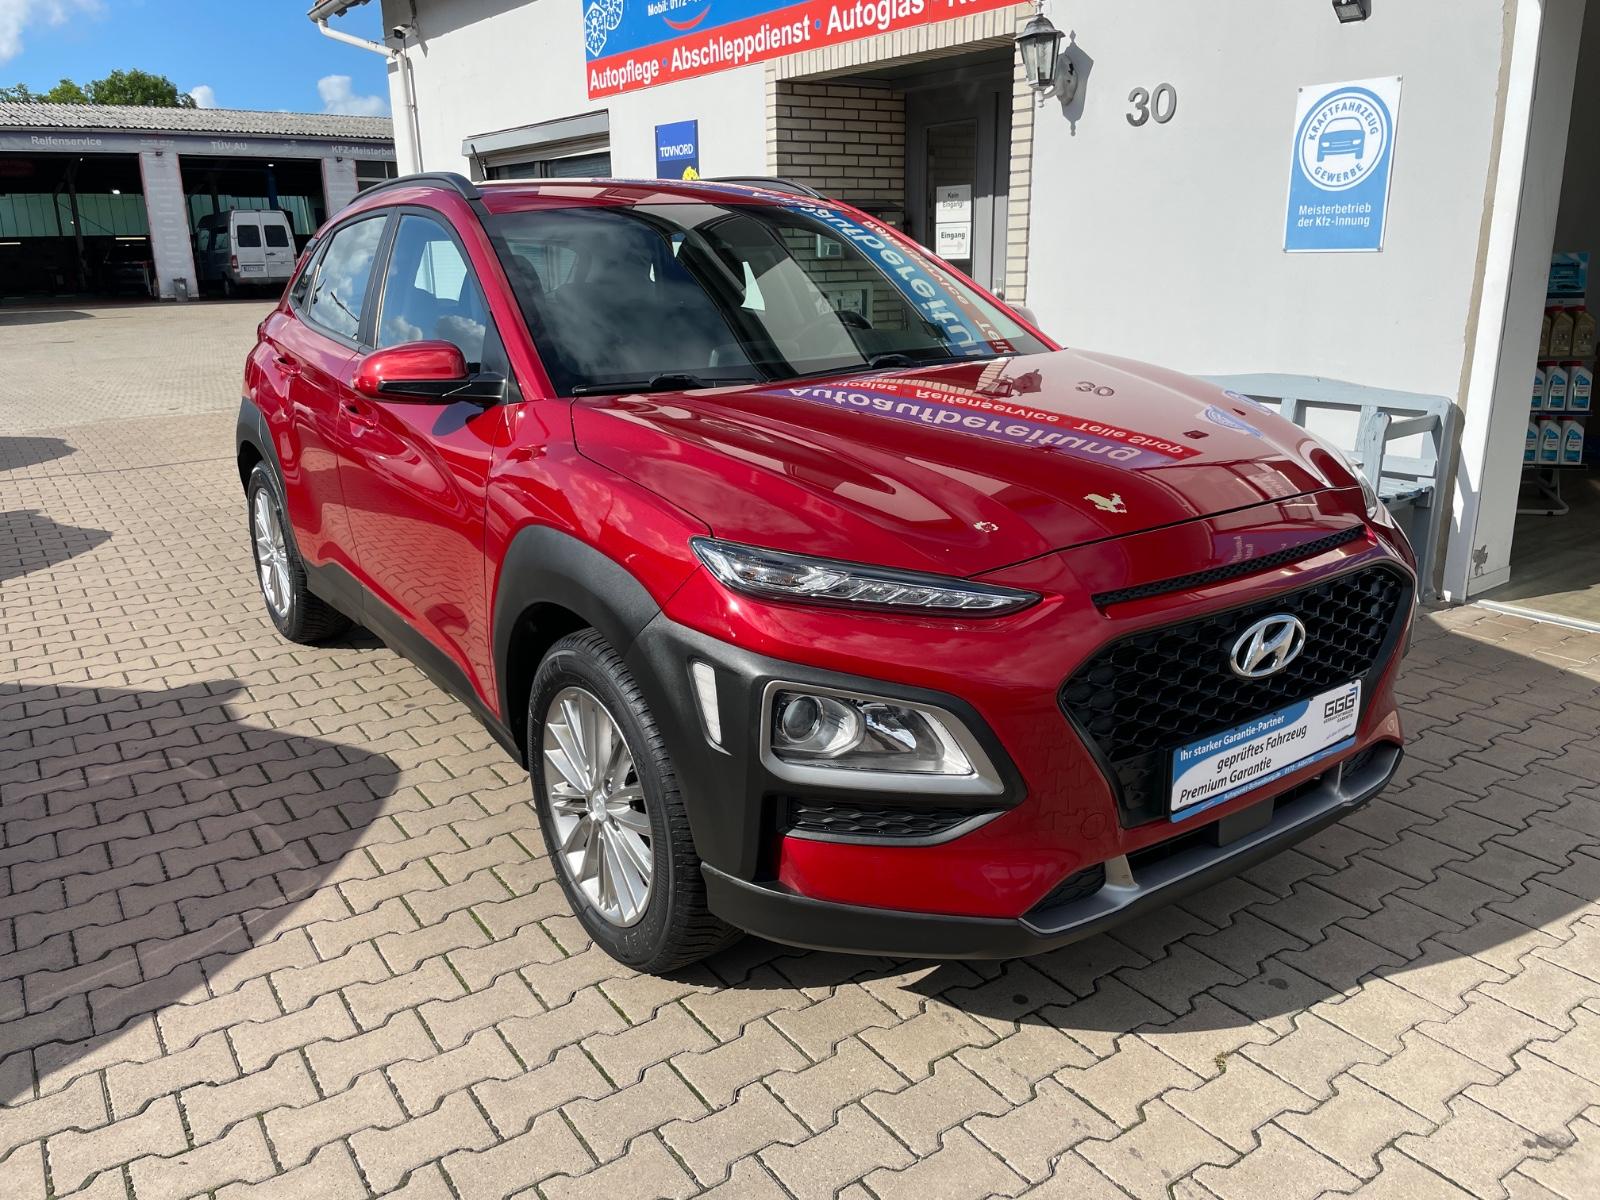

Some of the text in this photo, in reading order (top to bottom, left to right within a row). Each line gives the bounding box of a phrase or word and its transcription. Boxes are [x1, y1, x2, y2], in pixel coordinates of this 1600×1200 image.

[589, 0, 925, 92] Autopflege Abschleppdienst Autoglas
[1125, 82, 1178, 127] 30
[1307, 101, 1379, 141] KRAFTFAHRZEUG
[31, 135, 103, 147] Reifenservice
[1314, 163, 1364, 183] GEWERBE
[1297, 215, 1370, 228] der Kfz-Innung
[1298, 202, 1372, 216] Meisterbetrieb
[940, 231, 966, 240] Eingang
[1323, 692, 1356, 719] GGG
[1180, 714, 1286, 761] Ihr starker Garantie-Partner
[1216, 743, 1265, 774] geprüftes
[1266, 724, 1308, 751] Fahrzeug
[1179, 776, 1228, 803] Premium
[1229, 756, 1272, 784] Garantie
